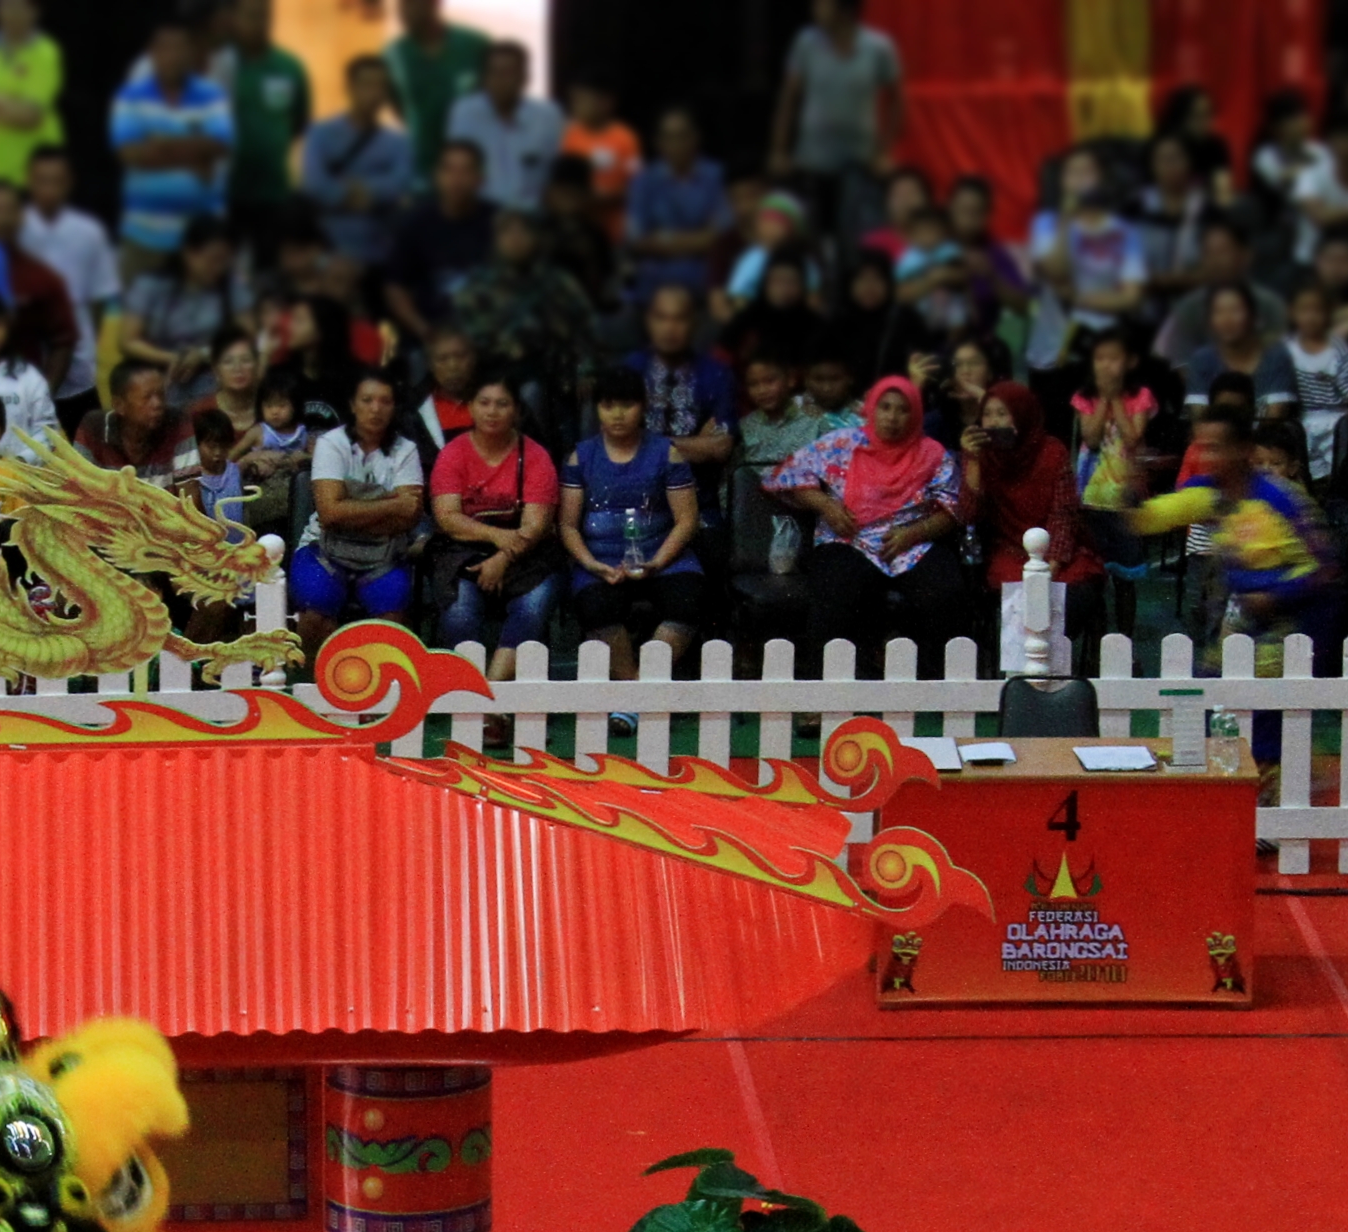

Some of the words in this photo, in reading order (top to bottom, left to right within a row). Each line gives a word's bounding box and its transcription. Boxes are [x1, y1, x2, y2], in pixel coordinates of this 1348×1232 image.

[1047, 789, 1081, 841] 4
[1029, 911, 1098, 922] FEDERASI
[1006, 923, 1124, 940] OLAHRAGA
[1001, 942, 1129, 959] BARONGSAI
[1003, 961, 1071, 971] INDONESIA
